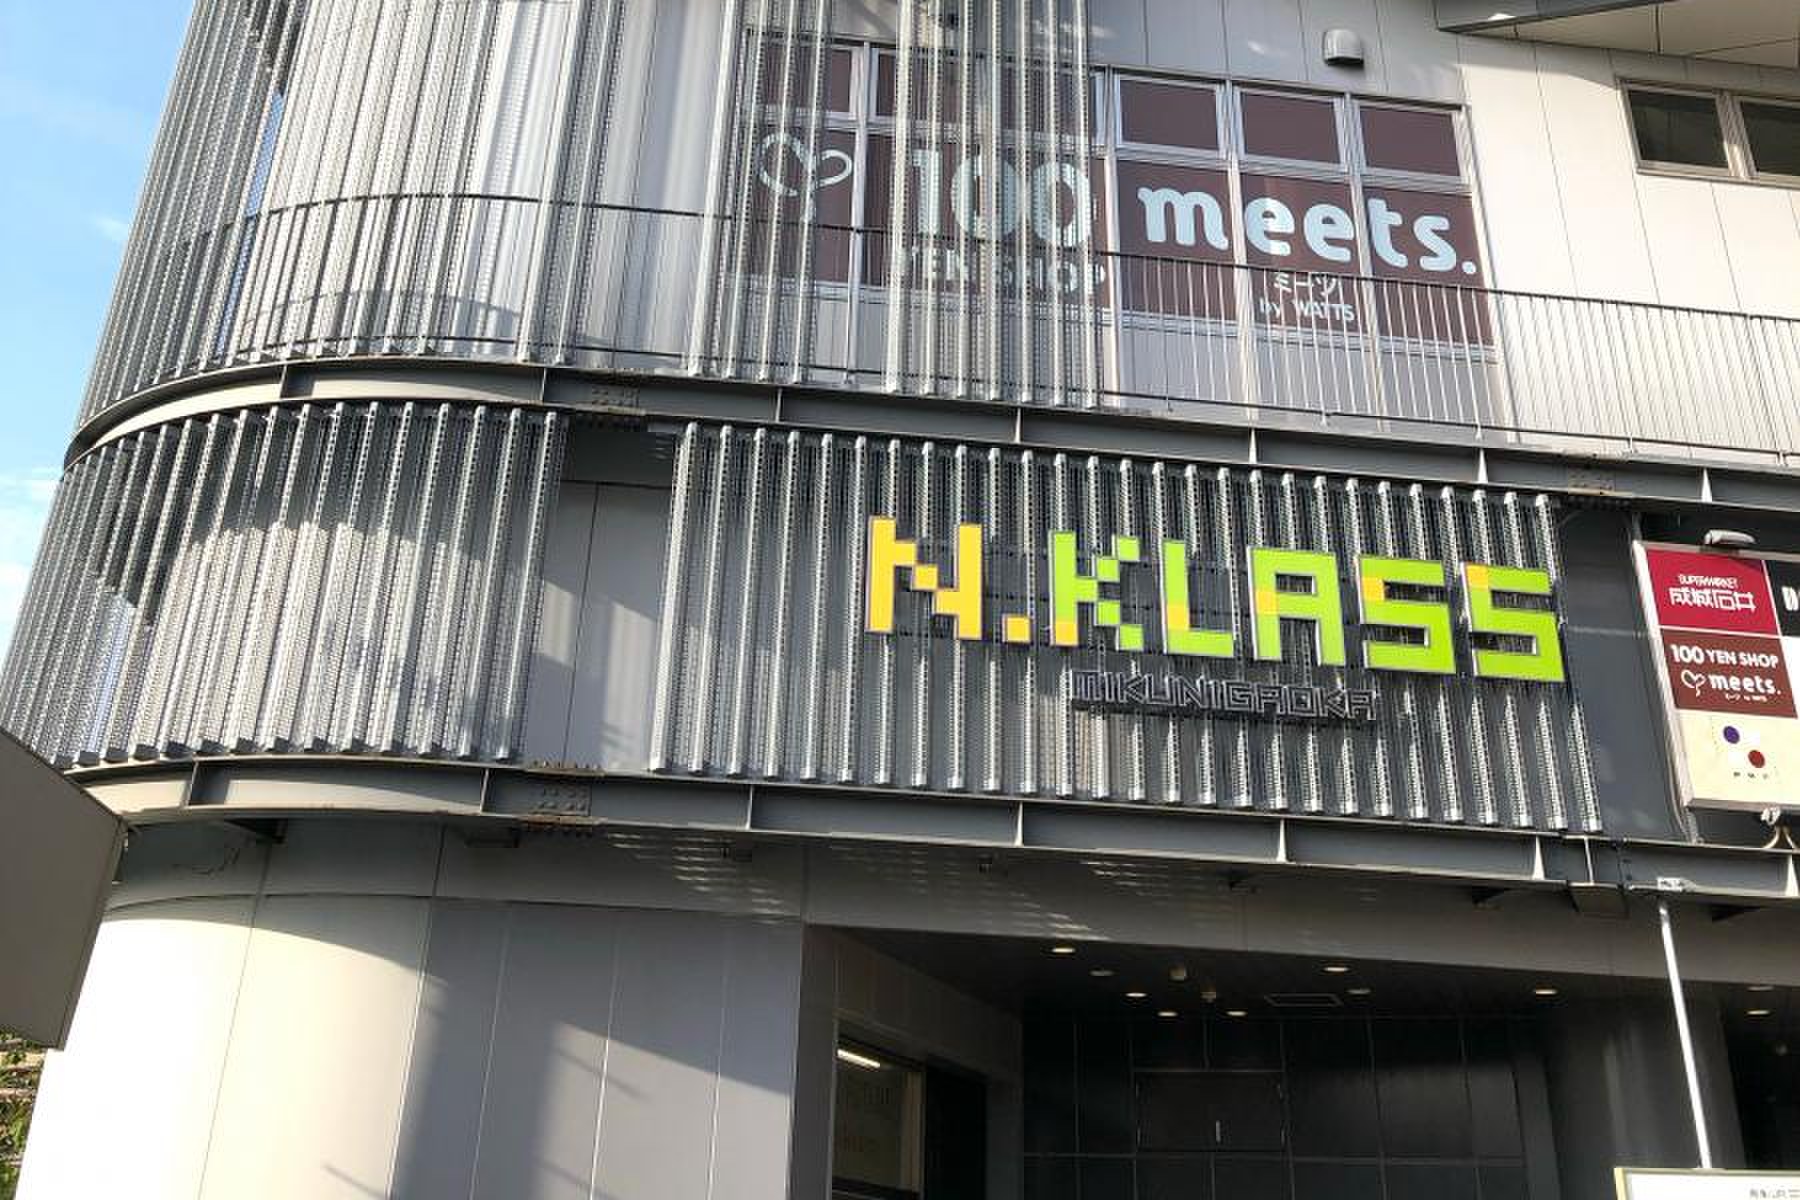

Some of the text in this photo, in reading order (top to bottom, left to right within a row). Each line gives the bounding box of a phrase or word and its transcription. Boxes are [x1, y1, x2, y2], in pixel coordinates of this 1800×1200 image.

[912, 149, 1093, 247] 100
[1292, 300, 1355, 322] WATTS
[865, 516, 1566, 683] N.KLASS
[1670, 644, 1779, 668] 100 YEN SHOP
[1071, 669, 1377, 721] MIKUNIGAOKA
